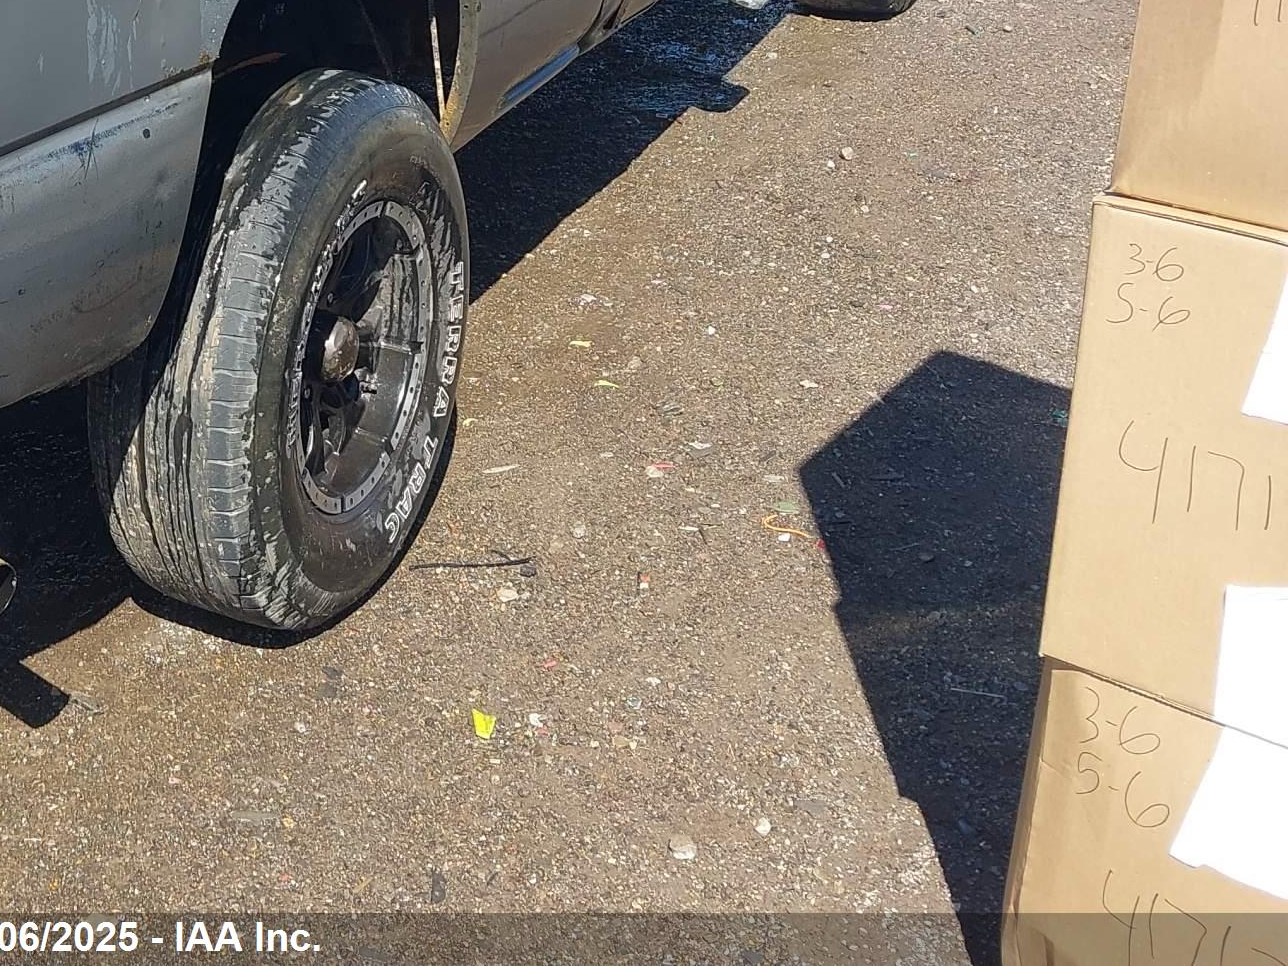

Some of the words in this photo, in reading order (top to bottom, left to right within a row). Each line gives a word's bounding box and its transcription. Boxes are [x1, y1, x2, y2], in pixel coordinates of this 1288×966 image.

[1124, 242, 1185, 282] 3-6
[432, 261, 464, 418] TERRA
[1105, 282, 1191, 332] 5-6
[384, 435, 439, 544] TRAC
[1118, 419, 1272, 531] 4171
[1079, 686, 1161, 755] 3-6
[1076, 751, 1170, 828] 5-6
